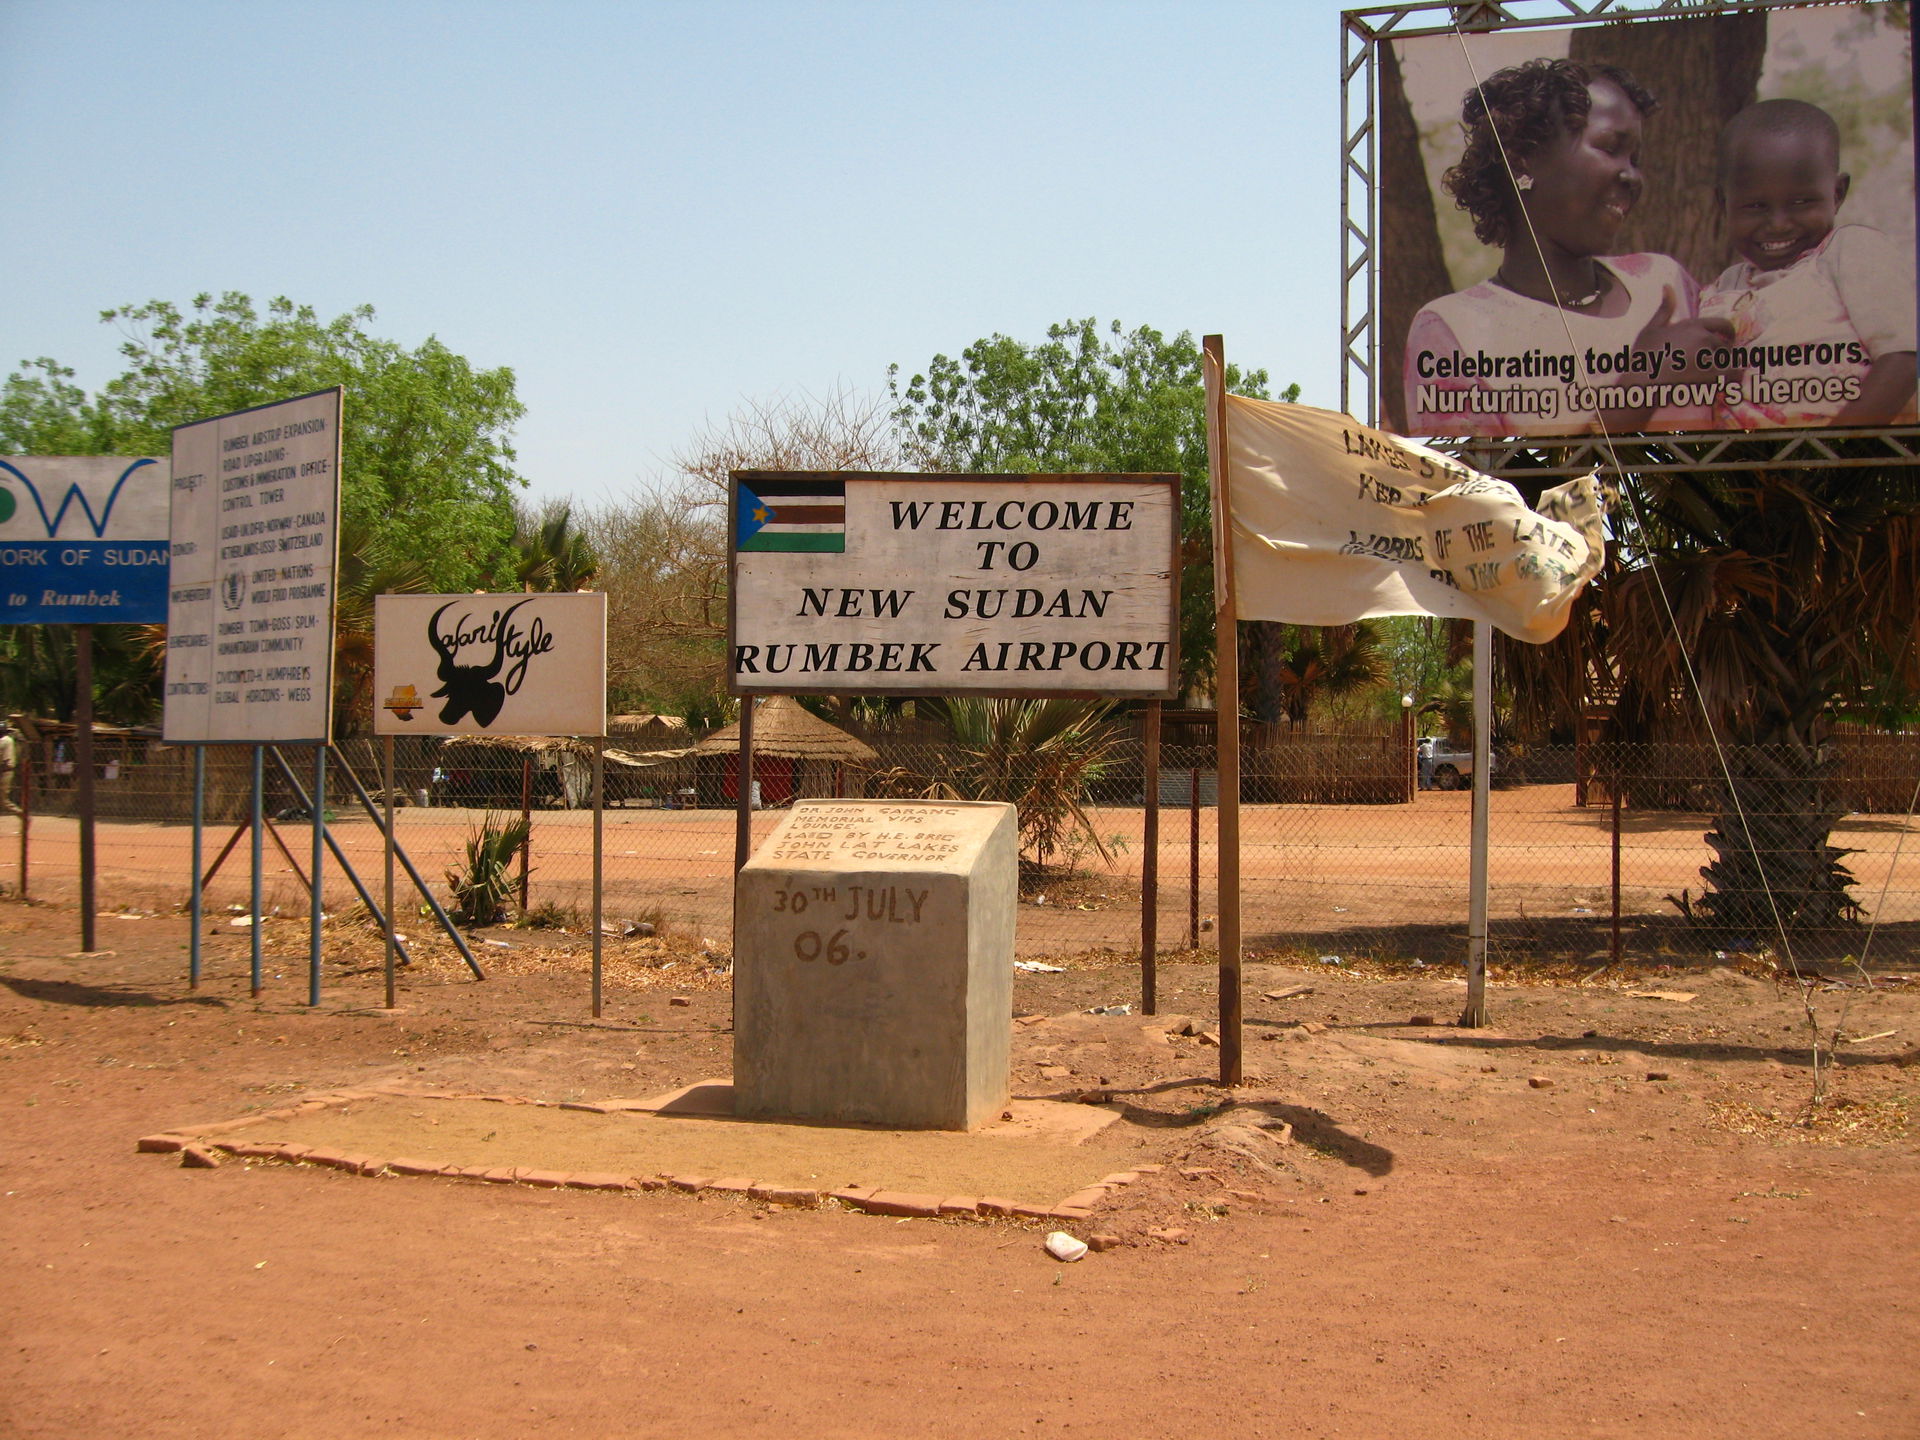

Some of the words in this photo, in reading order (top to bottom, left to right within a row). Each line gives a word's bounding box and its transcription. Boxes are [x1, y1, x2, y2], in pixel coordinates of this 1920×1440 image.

[1416, 349, 1576, 383] Celebrating
[1585, 342, 1687, 379] today's
[1696, 341, 1871, 375] conquerors,
[1416, 384, 1559, 418] Nurturing
[1567, 375, 1742, 412] tomorrow's
[1752, 374, 1862, 405] heroes
[889, 501, 1135, 531] WELCOME
[1435, 528, 1452, 560] OF
[1463, 520, 1495, 553] THE
[1513, 519, 1576, 560] LATE
[61, 549, 91, 566] OF
[977, 541, 1039, 571] TO
[282, 563, 313, 580] NATIONS
[8, 592, 27, 606] to
[40, 589, 122, 607] Rumbek
[796, 588, 915, 618] NEW
[944, 588, 1113, 619] SUDAN
[736, 643, 941, 673] RUMBEK
[961, 641, 1169, 671] AIRPORT
[794, 815, 875, 824] MEMORIAL
[825, 806, 865, 814] JOHN
[776, 841, 832, 850] JOHN
[840, 841, 887, 850] LAT
[896, 842, 960, 853] LAKES
[845, 832, 870, 840] BY
[772, 850, 834, 861] STATE
[851, 850, 948, 862] GOVERNOR
[844, 886, 930, 924] JULY
